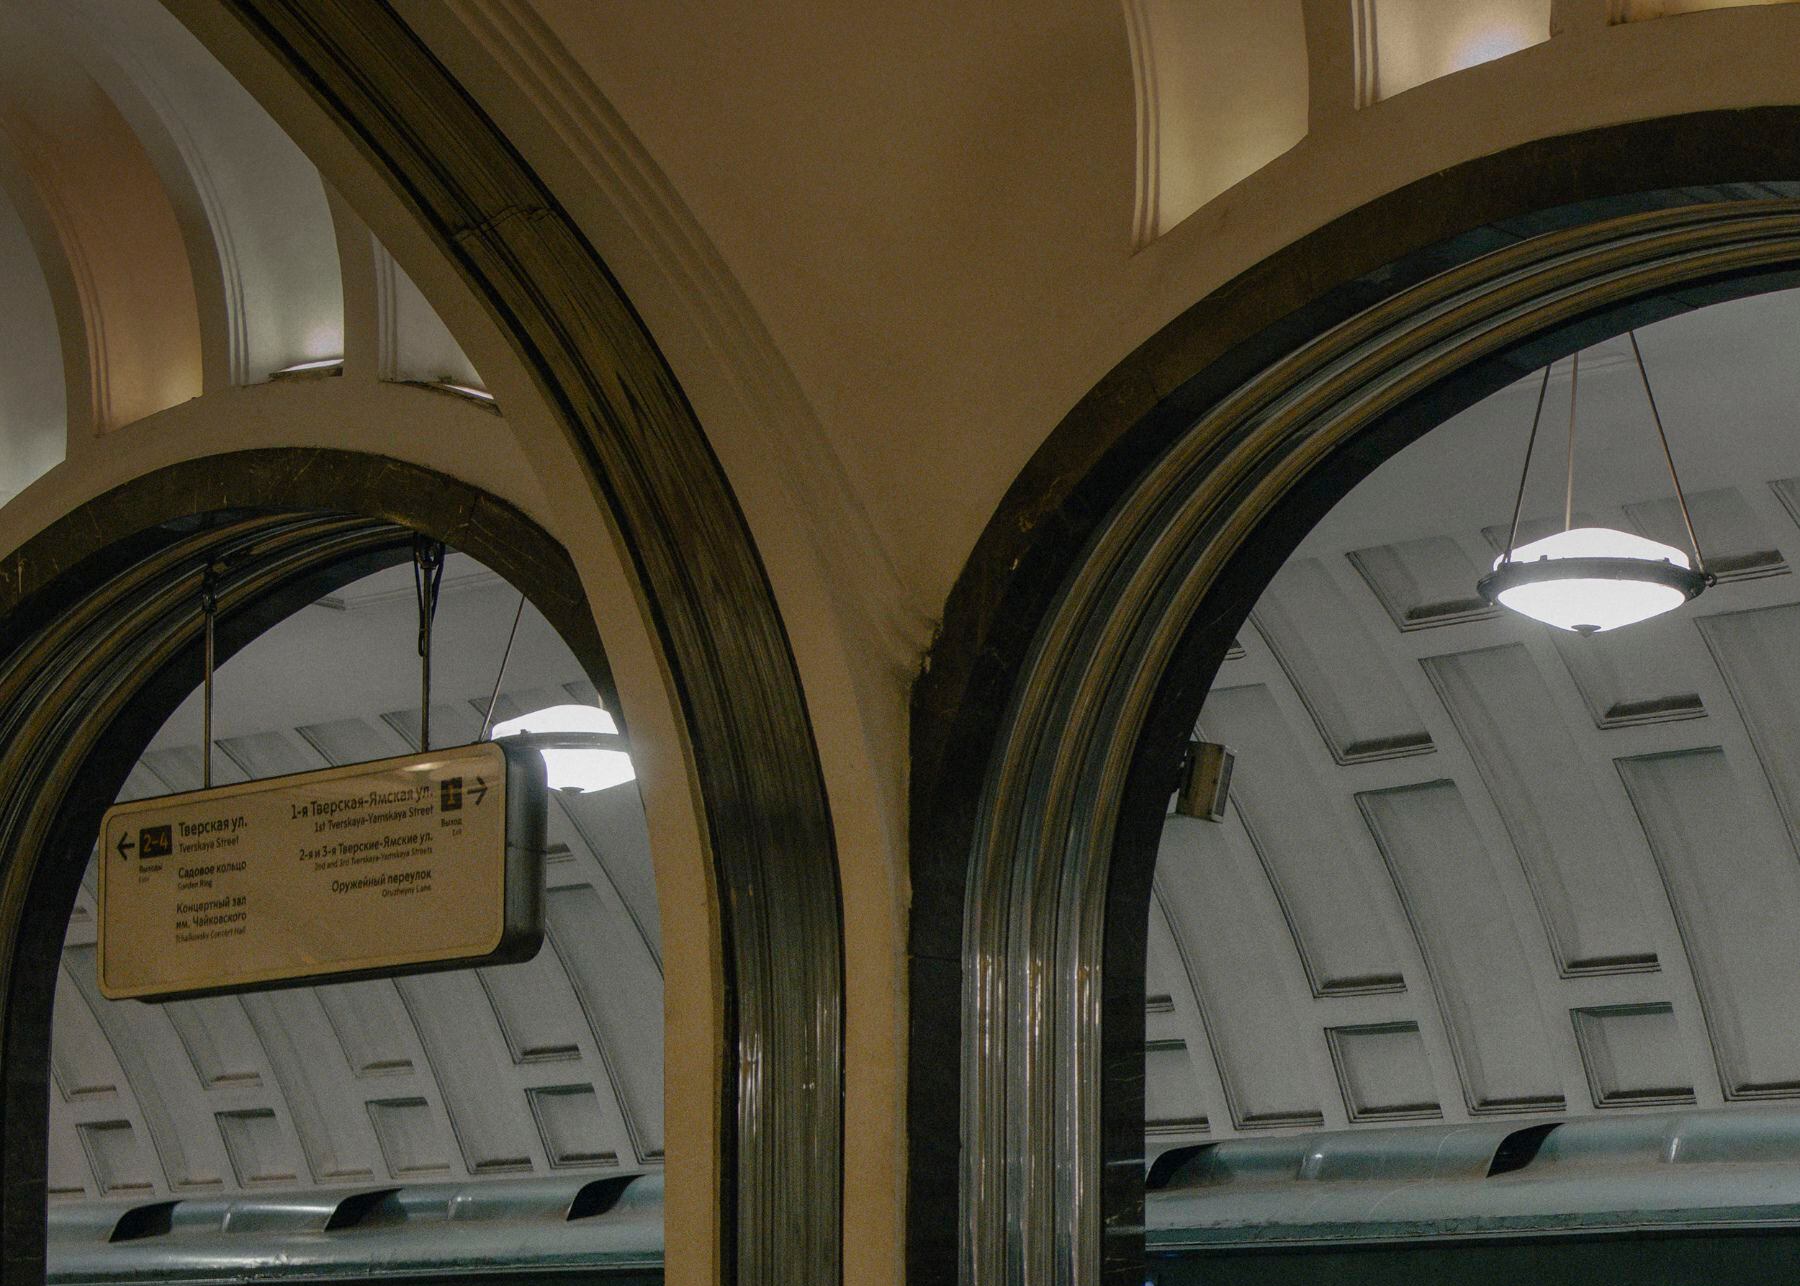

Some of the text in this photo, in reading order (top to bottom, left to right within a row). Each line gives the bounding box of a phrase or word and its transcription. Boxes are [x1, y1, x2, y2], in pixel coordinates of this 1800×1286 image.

[448, 784, 454, 804] 1
[291, 804, 308, 819] 1-я
[310, 791, 413, 816] Тверская-Ямская
[179, 816, 247, 838] Тверская ул.
[314, 805, 433, 833] 1st Tverskaya-Yamskaya Street
[143, 831, 168, 852] 2-4
[179, 836, 239, 854] Tverskaya Street
[300, 849, 313, 860] 2-я
[322, 845, 336, 857] 3-я
[338, 836, 417, 856] Тверские-Ямские
[420, 832, 433, 846] ул.
[178, 860, 246, 879] Садовое кольцо
[332, 870, 431, 893] Оружейный переулок
[176, 896, 246, 914] Концертный зал
[176, 911, 246, 930] им. Чайковского
